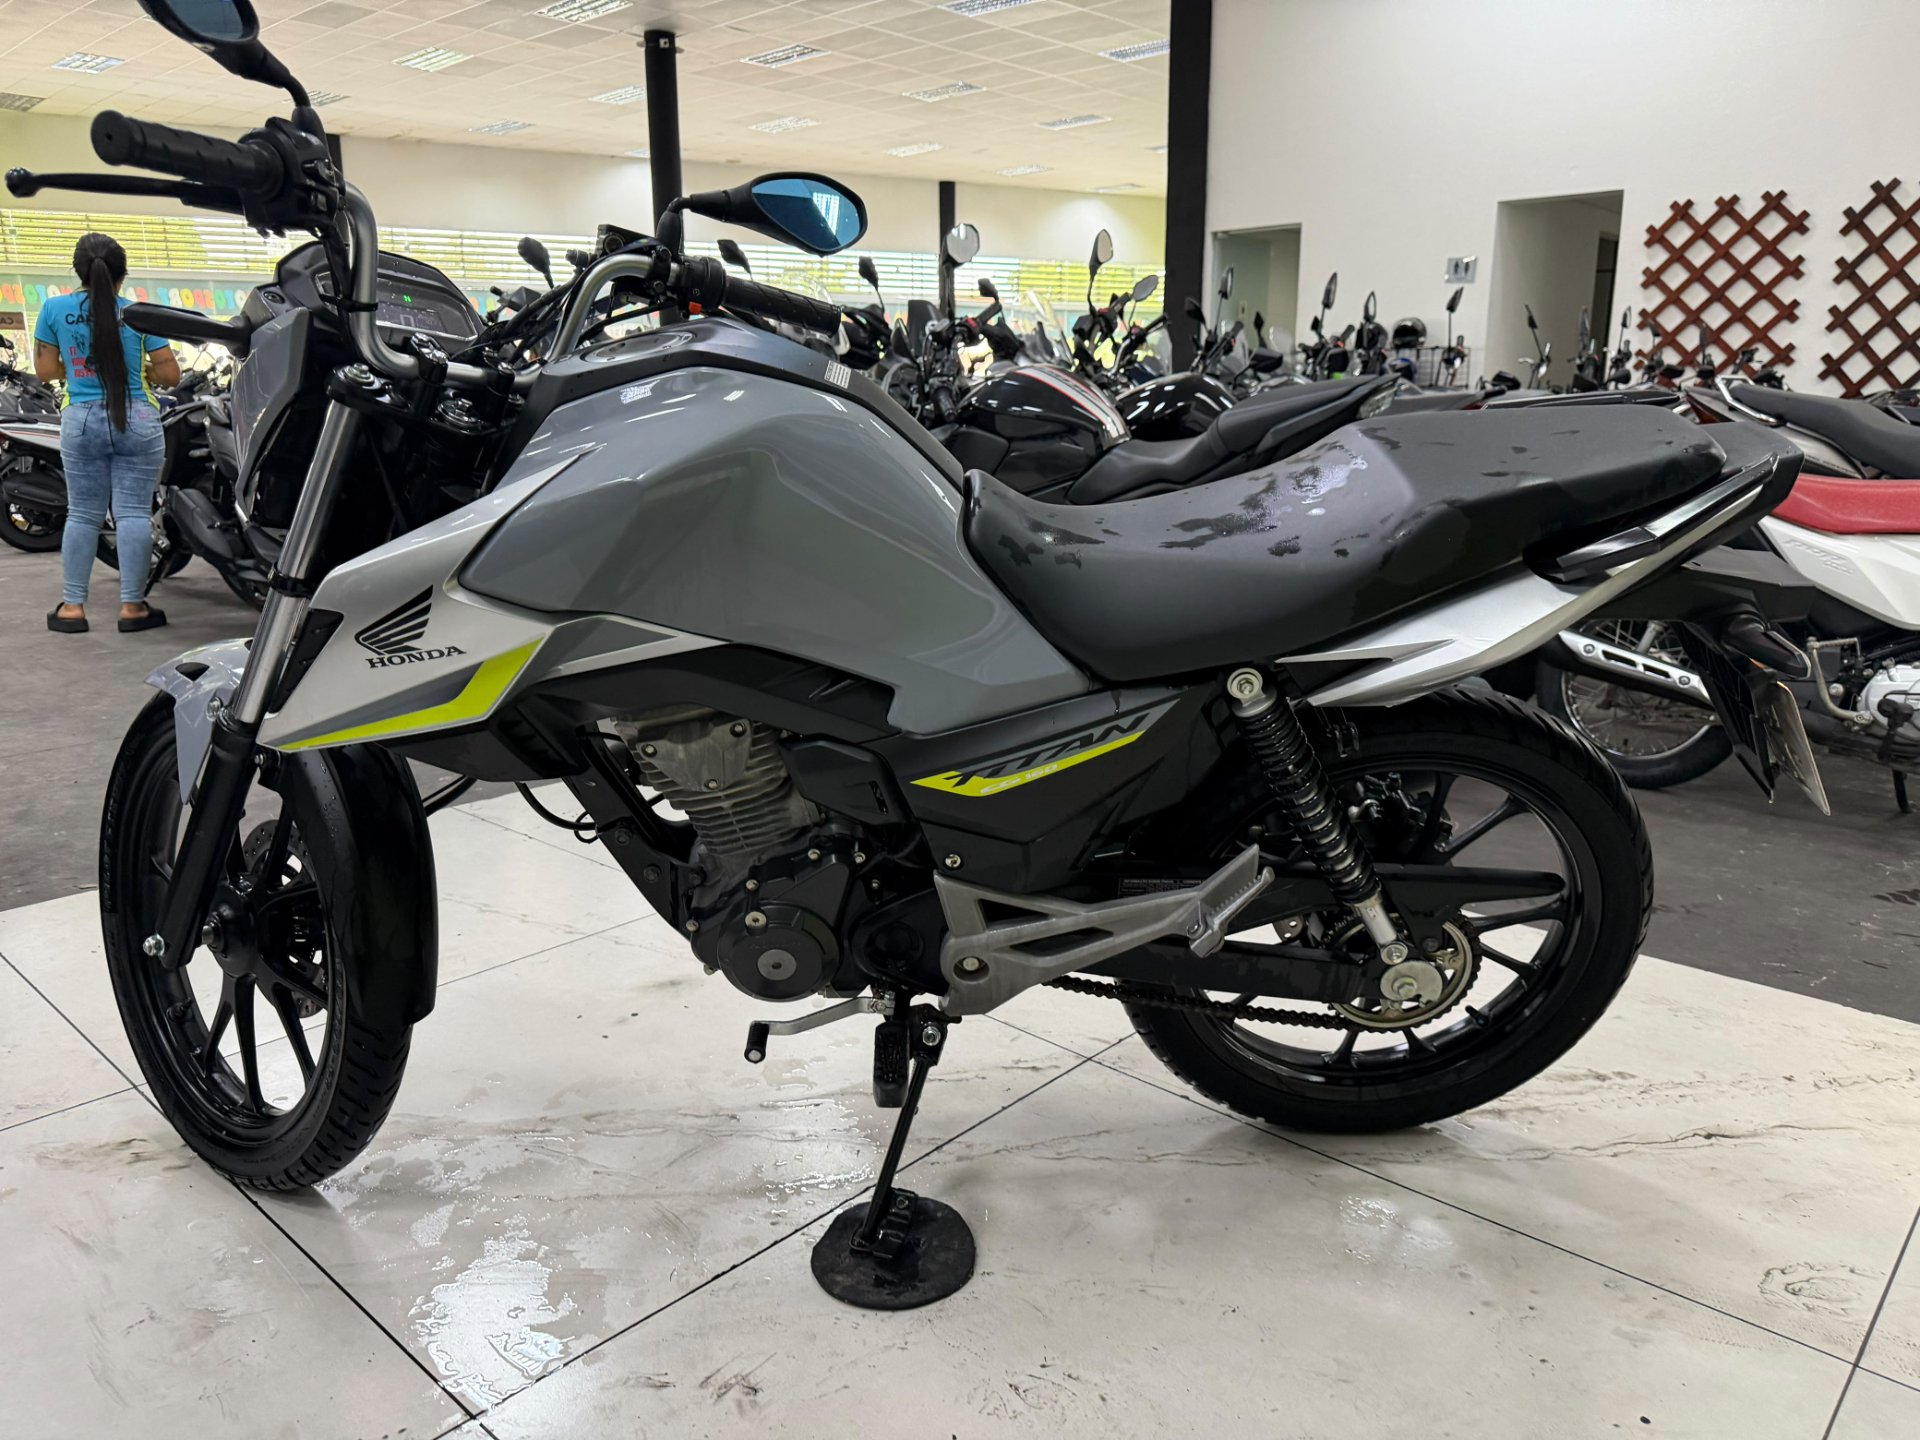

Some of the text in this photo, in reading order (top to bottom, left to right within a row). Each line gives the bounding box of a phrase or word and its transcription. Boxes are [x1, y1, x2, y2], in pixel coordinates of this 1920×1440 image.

[366, 645, 467, 669] HONDA
[943, 712, 1151, 788] TITAN
[980, 763, 1058, 795] CG 160
